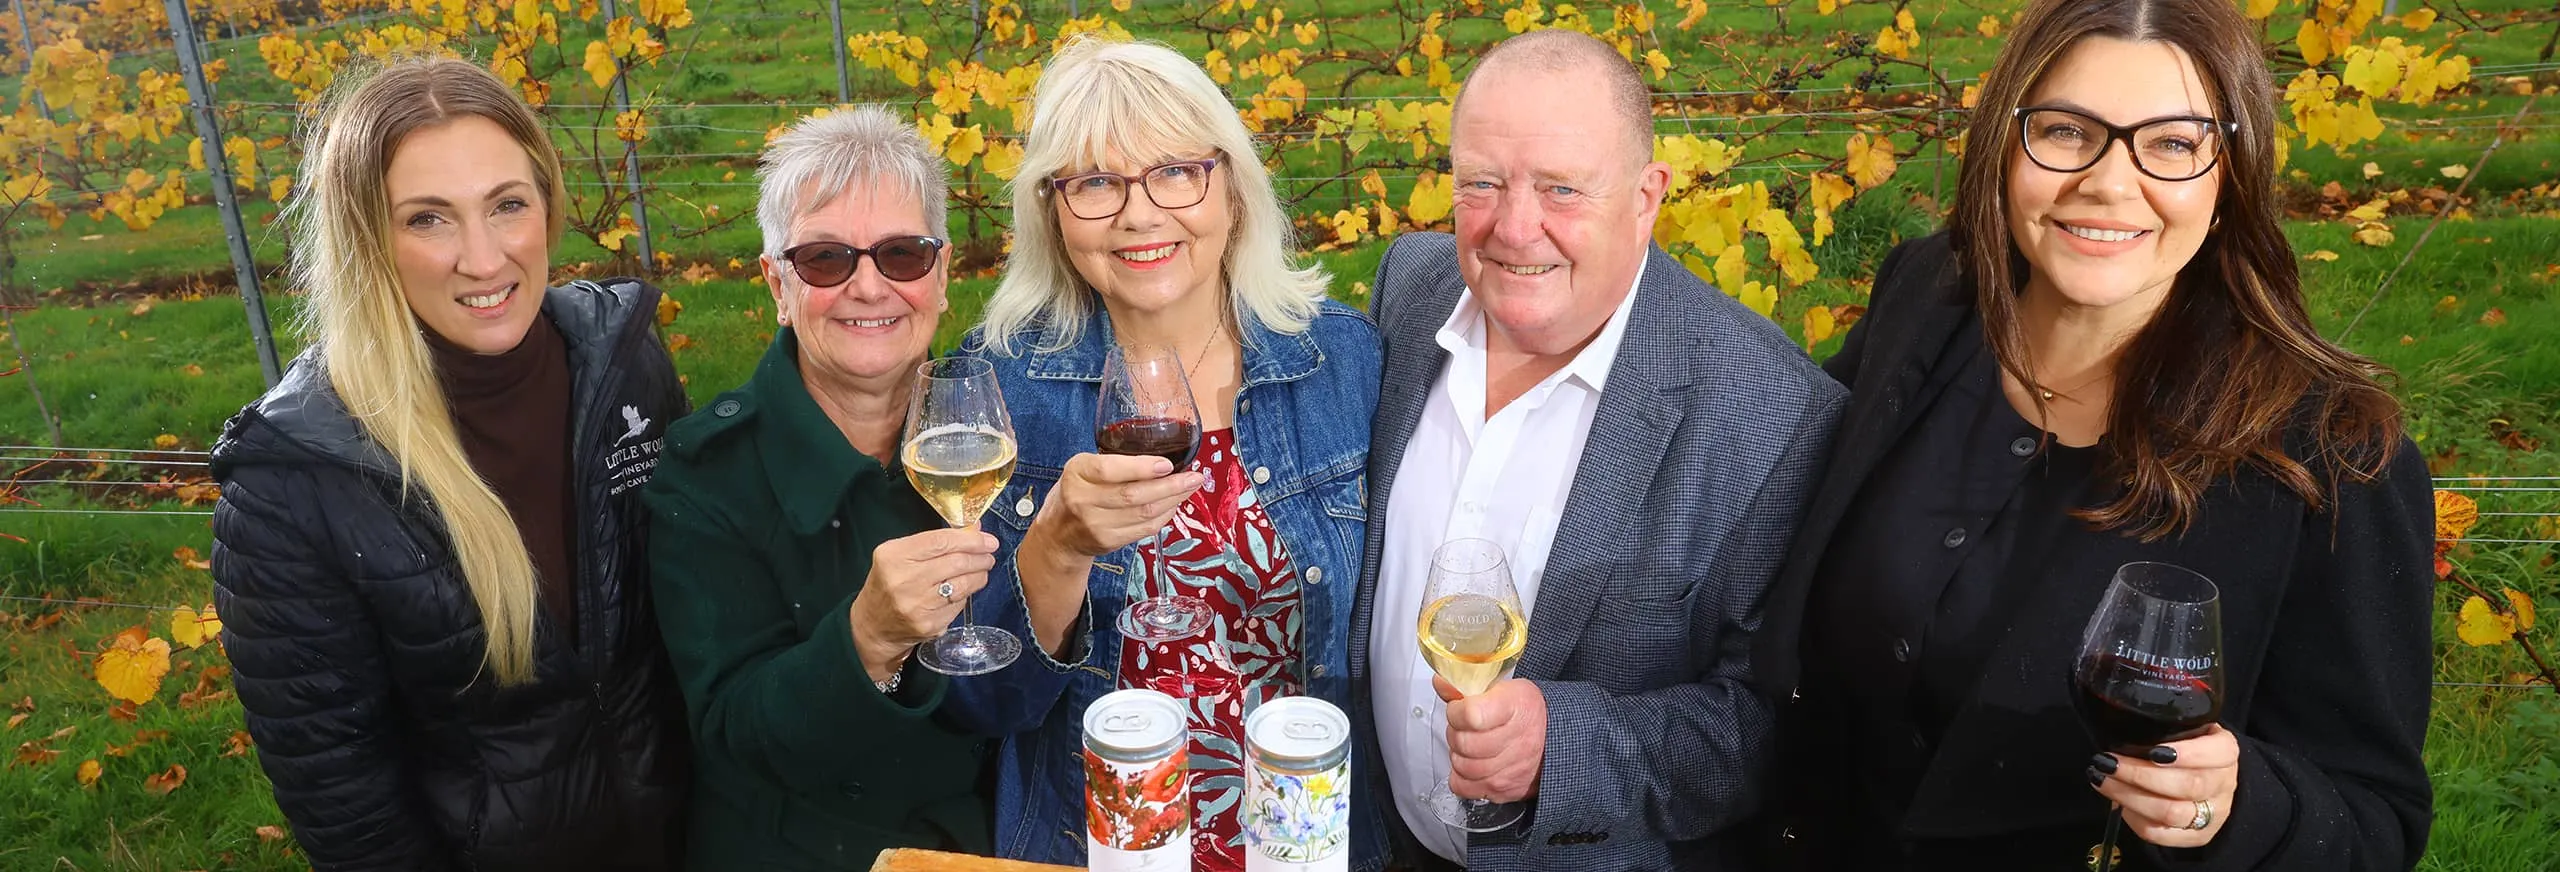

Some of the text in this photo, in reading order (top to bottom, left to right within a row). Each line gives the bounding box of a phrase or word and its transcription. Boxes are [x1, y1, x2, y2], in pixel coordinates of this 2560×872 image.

[605, 436, 663, 469] LITTLE WOL
[627, 475, 648, 487] CAVE
[1457, 614, 1490, 625] WOLD
[2116, 645, 2211, 671] LITTLE WOLD
[2142, 669, 2186, 681] VINEYARD
